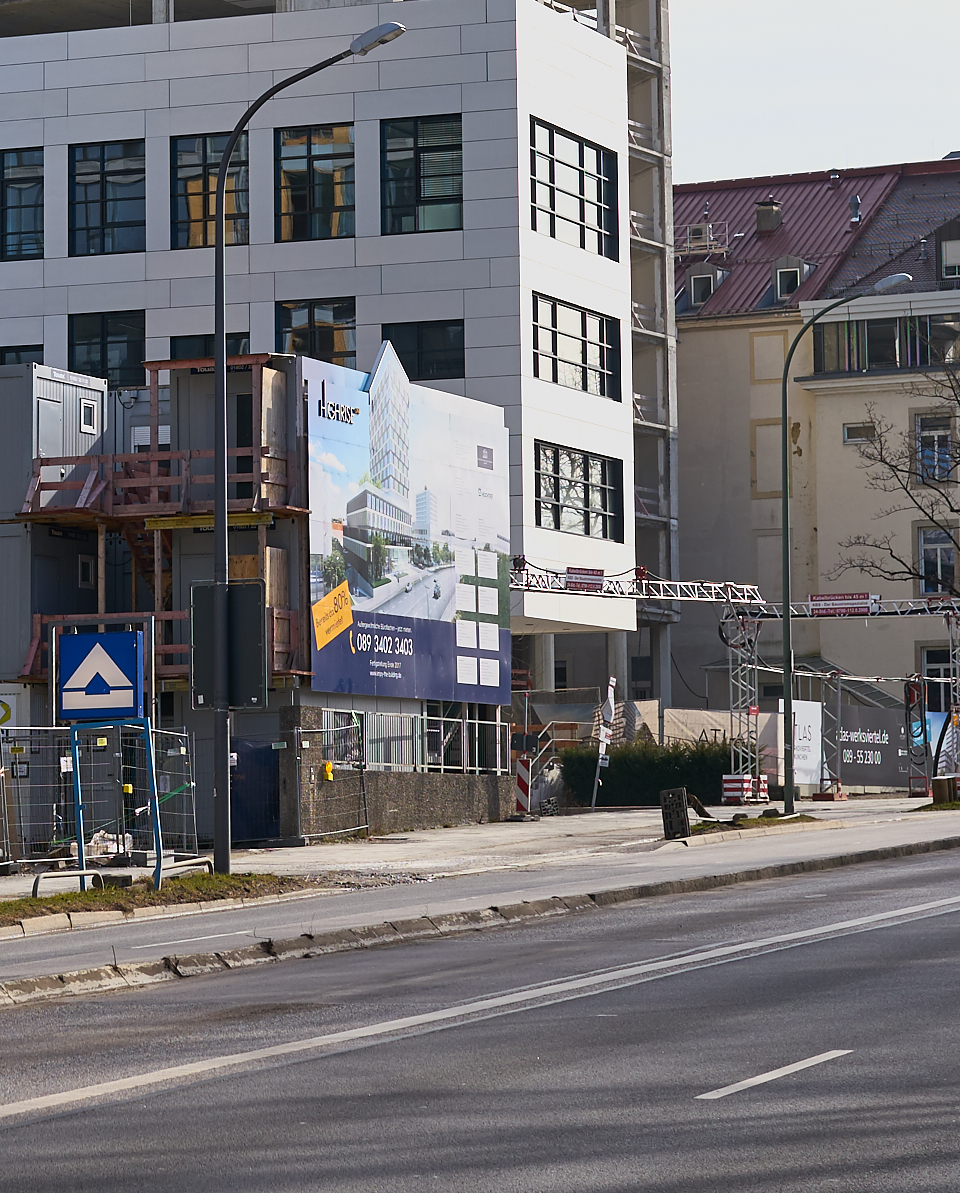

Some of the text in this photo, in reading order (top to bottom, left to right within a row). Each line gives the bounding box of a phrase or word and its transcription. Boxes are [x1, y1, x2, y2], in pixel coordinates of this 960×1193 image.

[333, 591, 348, 613] 80%
[357, 633, 413, 656] 089 3402 3403
[842, 749, 853, 763] 089
